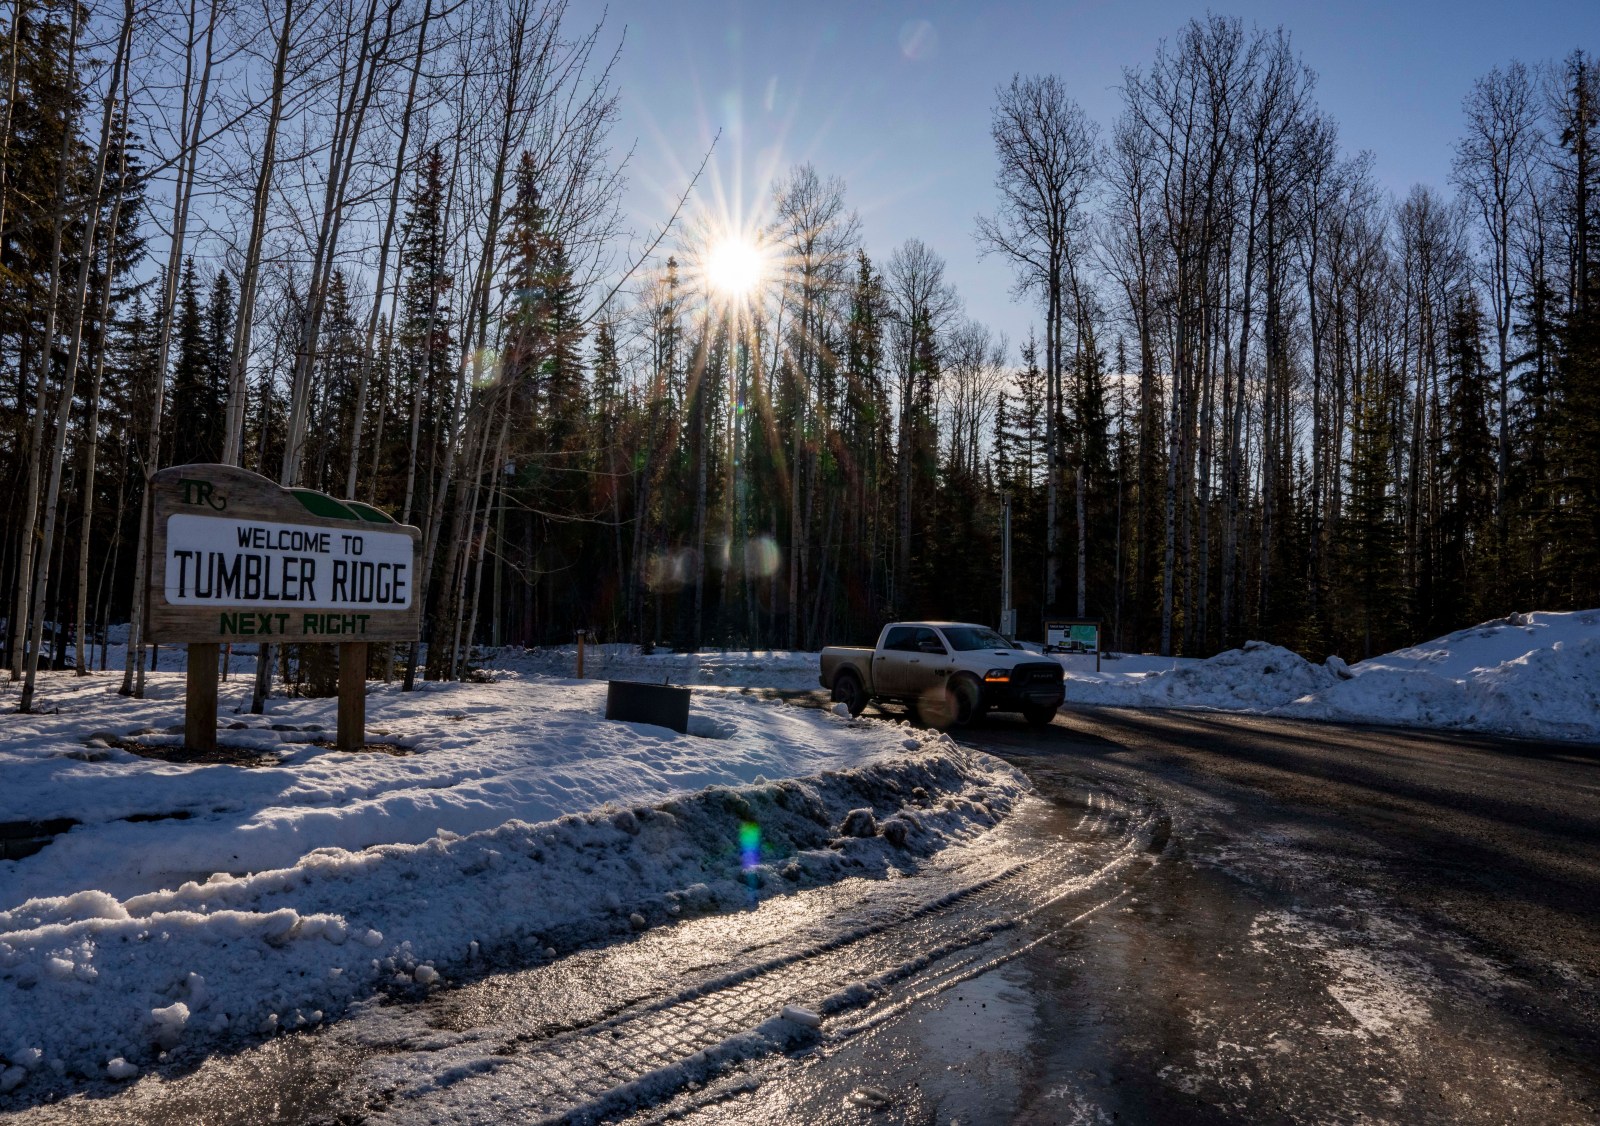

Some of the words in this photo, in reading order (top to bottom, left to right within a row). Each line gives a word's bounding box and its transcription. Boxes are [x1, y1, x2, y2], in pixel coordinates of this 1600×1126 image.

[177, 478, 227, 511] TR
[237, 526, 331, 553] WELCOME
[341, 534, 363, 556] TO
[173, 550, 316, 601] TUMBLER
[331, 559, 407, 604] RIDGE
[219, 612, 290, 635] NEXT
[302, 613, 371, 634] RIGHT
